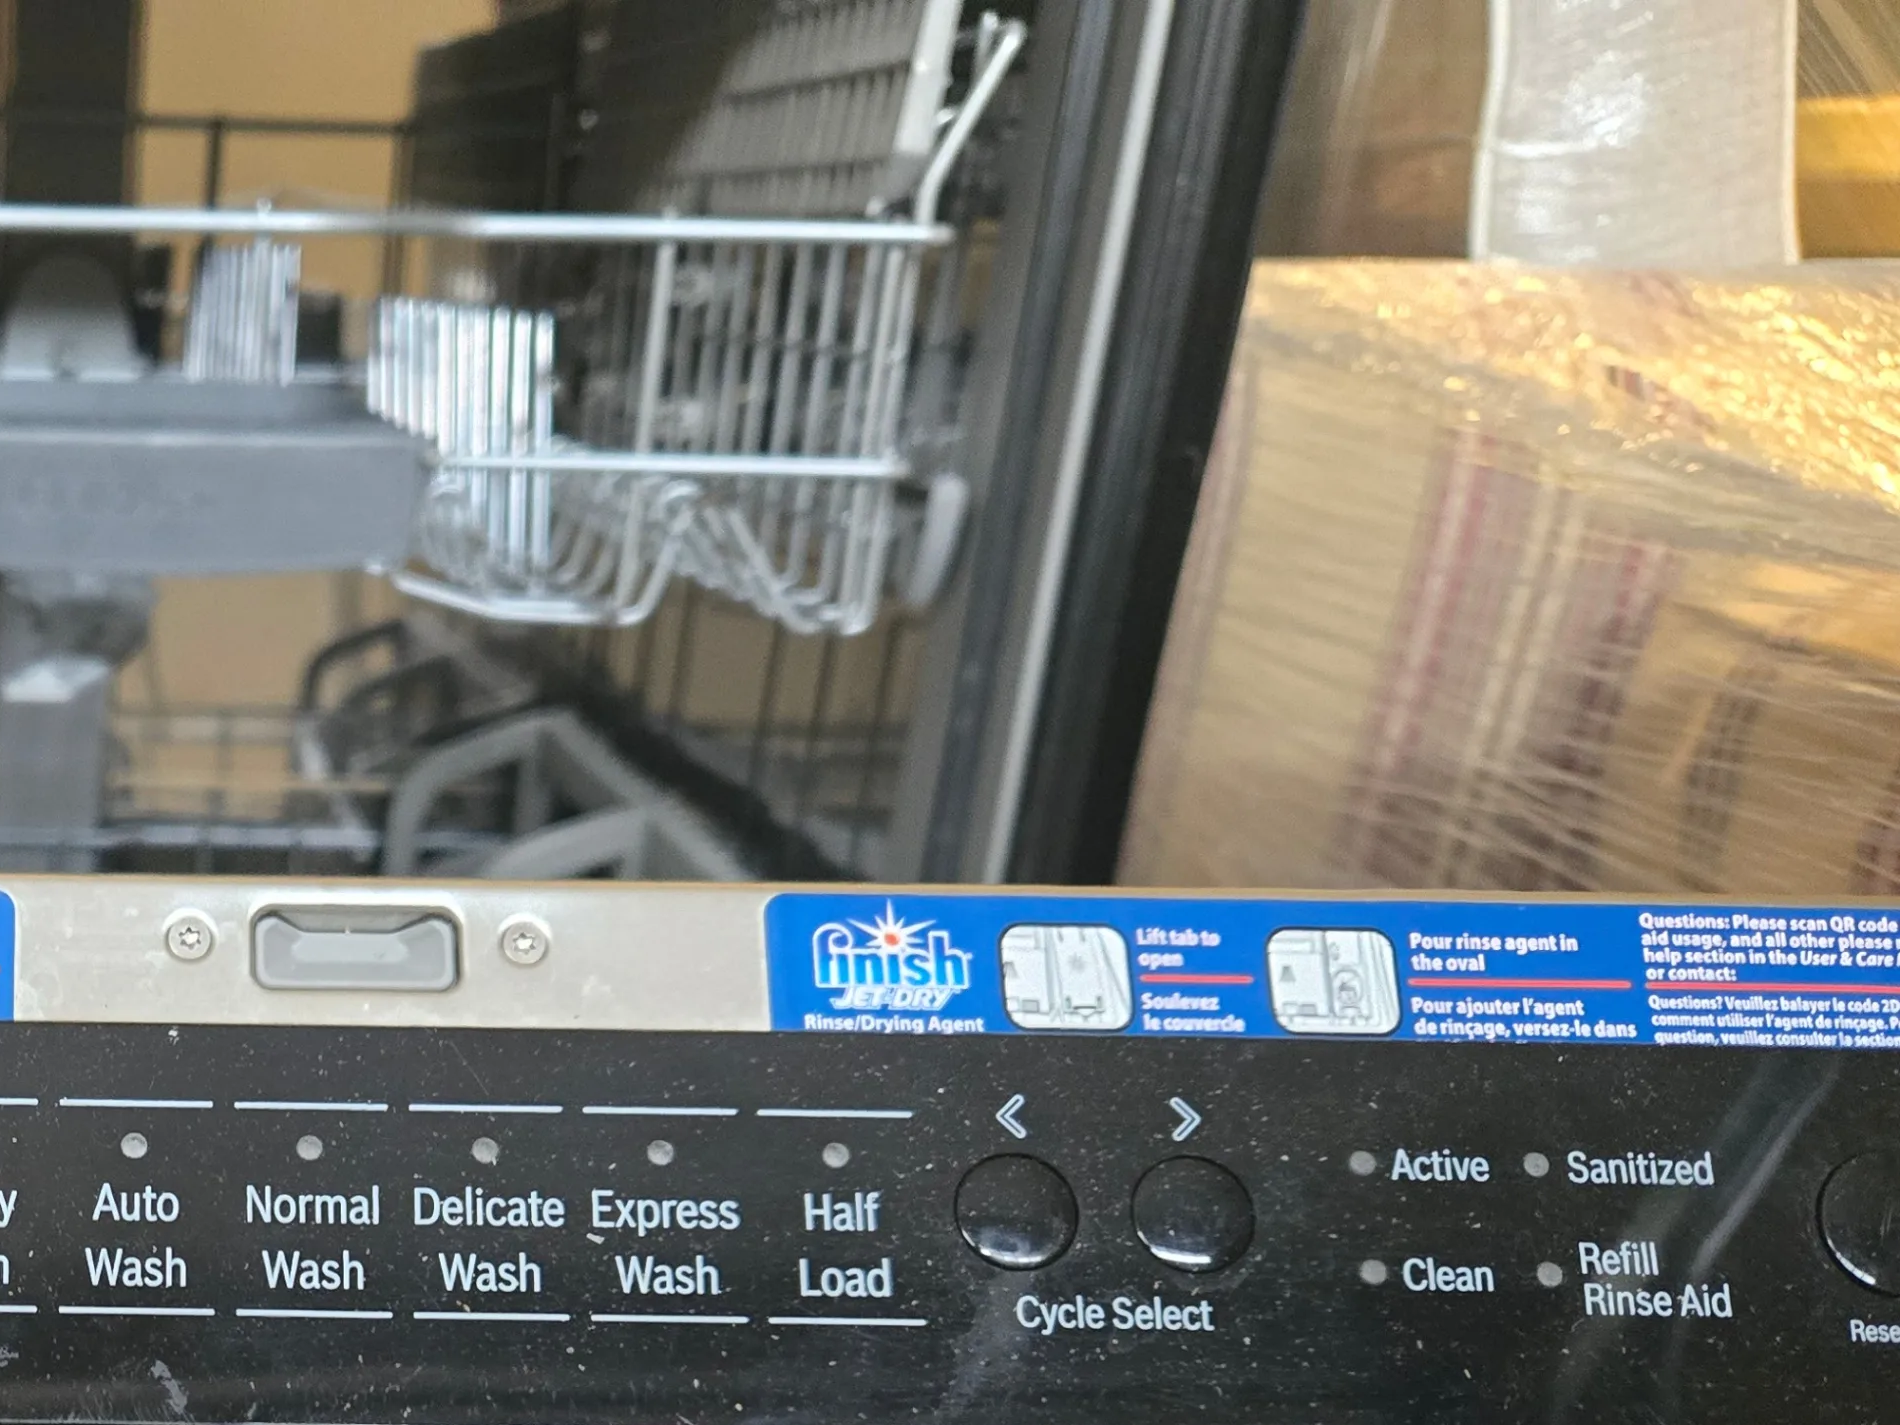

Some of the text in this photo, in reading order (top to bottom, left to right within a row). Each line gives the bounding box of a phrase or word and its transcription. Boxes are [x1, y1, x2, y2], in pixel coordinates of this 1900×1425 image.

[1639, 912, 1898, 934] Questions: Please scan QR code
[812, 922, 970, 989] finish
[1408, 932, 1579, 955] Pour rinse agent in
[1641, 930, 1669, 947] aid
[1671, 932, 1727, 950] usage,
[1730, 932, 1763, 948] and
[1765, 932, 1787, 949] all
[1789, 933, 1835, 950] other
[1837, 934, 1893, 952] please
[1643, 947, 1683, 966] help
[1684, 949, 1746, 965] section
[1748, 949, 1766, 965] in
[1768, 950, 1798, 966] the
[1799, 950, 1837, 967] User
[1839, 951, 1853, 966] &
[1855, 951, 1894, 968] Care
[1411, 953, 1486, 972] the oval
[1646, 967, 1737, 982] or contact:
[1142, 1012, 1161, 1031] le
[1410, 996, 1453, 1014] Pour
[1456, 997, 1520, 1018] ajouter
[1648, 995, 1723, 1011] Questions?
[1780, 996, 1831, 1015] balayer
[1832, 997, 1845, 1012] le
[1848, 998, 1879, 1013] code
[1651, 1014, 1715, 1028] comment
[1815, 1015, 1832, 1030] de
[804, 1013, 985, 1033] Rinse/Drying Agent
[1413, 1017, 1437, 1036] de
[1512, 1019, 1592, 1038] versez-le
[1593, 1019, 1638, 1038] dans
[1839, 1033, 1853, 1047] la
[1390, 1148, 1492, 1183] Active
[1566, 1150, 1715, 1187] Sanitized
[92, 1183, 180, 1223] Auto
[245, 1185, 381, 1226] Normal
[412, 1186, 566, 1228] Delicate
[591, 1189, 741, 1237] Express
[803, 1193, 882, 1232] Half
[85, 1247, 187, 1287] Wash
[262, 1250, 366, 1292] Wash
[437, 1251, 542, 1293] Wash
[615, 1254, 720, 1296] Wash
[1401, 1258, 1495, 1293] Clean
[1579, 1241, 1659, 1277] Refill
[798, 1257, 893, 1299] Load
[1015, 1295, 1215, 1335] Cycle Select
[1584, 1283, 1733, 1319] Rinse Aid
